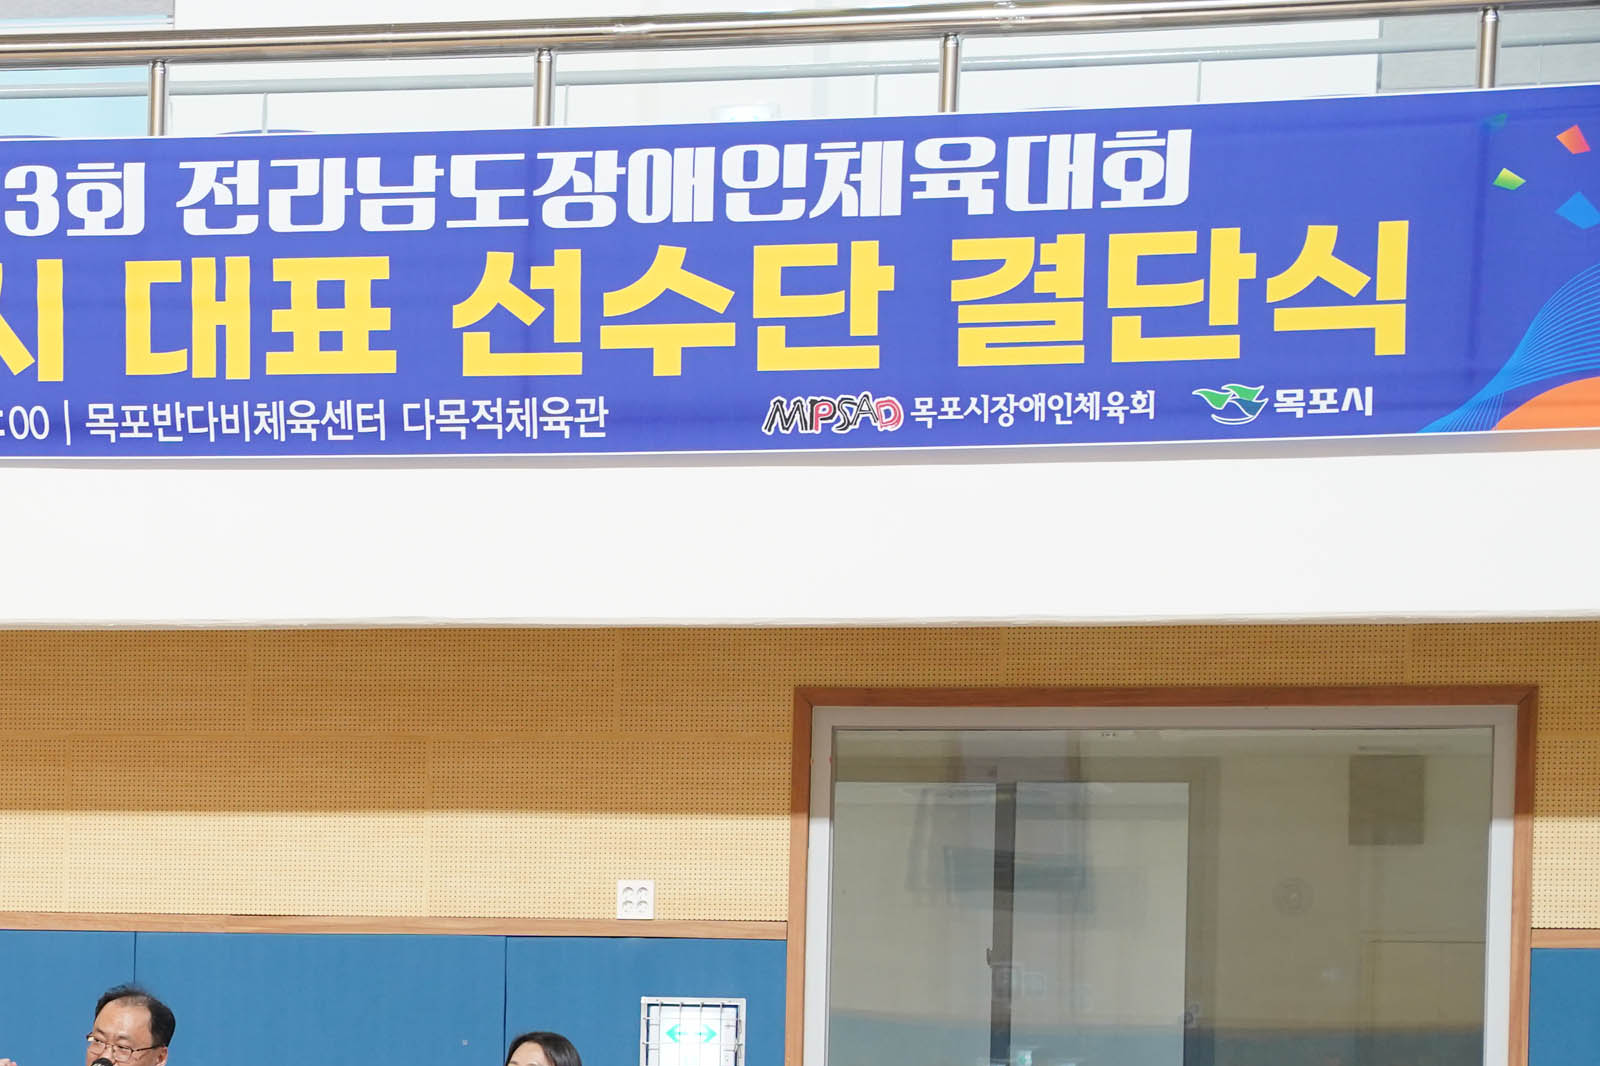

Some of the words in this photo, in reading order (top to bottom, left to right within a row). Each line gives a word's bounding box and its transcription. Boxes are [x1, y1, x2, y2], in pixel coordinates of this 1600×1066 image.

[177, 128, 1193, 238] 전라남도장애인체육대회
[125, 255, 397, 381] 대표
[452, 240, 895, 377] 선수단
[951, 220, 1409, 367] 결단식
[85, 399, 386, 443] 목포반다비체육센터
[402, 395, 609, 440] 다목적체육관
[761, 391, 905, 436] MPSAD
[910, 388, 1156, 428] 목포시장애인체육회
[1273, 386, 1373, 419] 목포시
